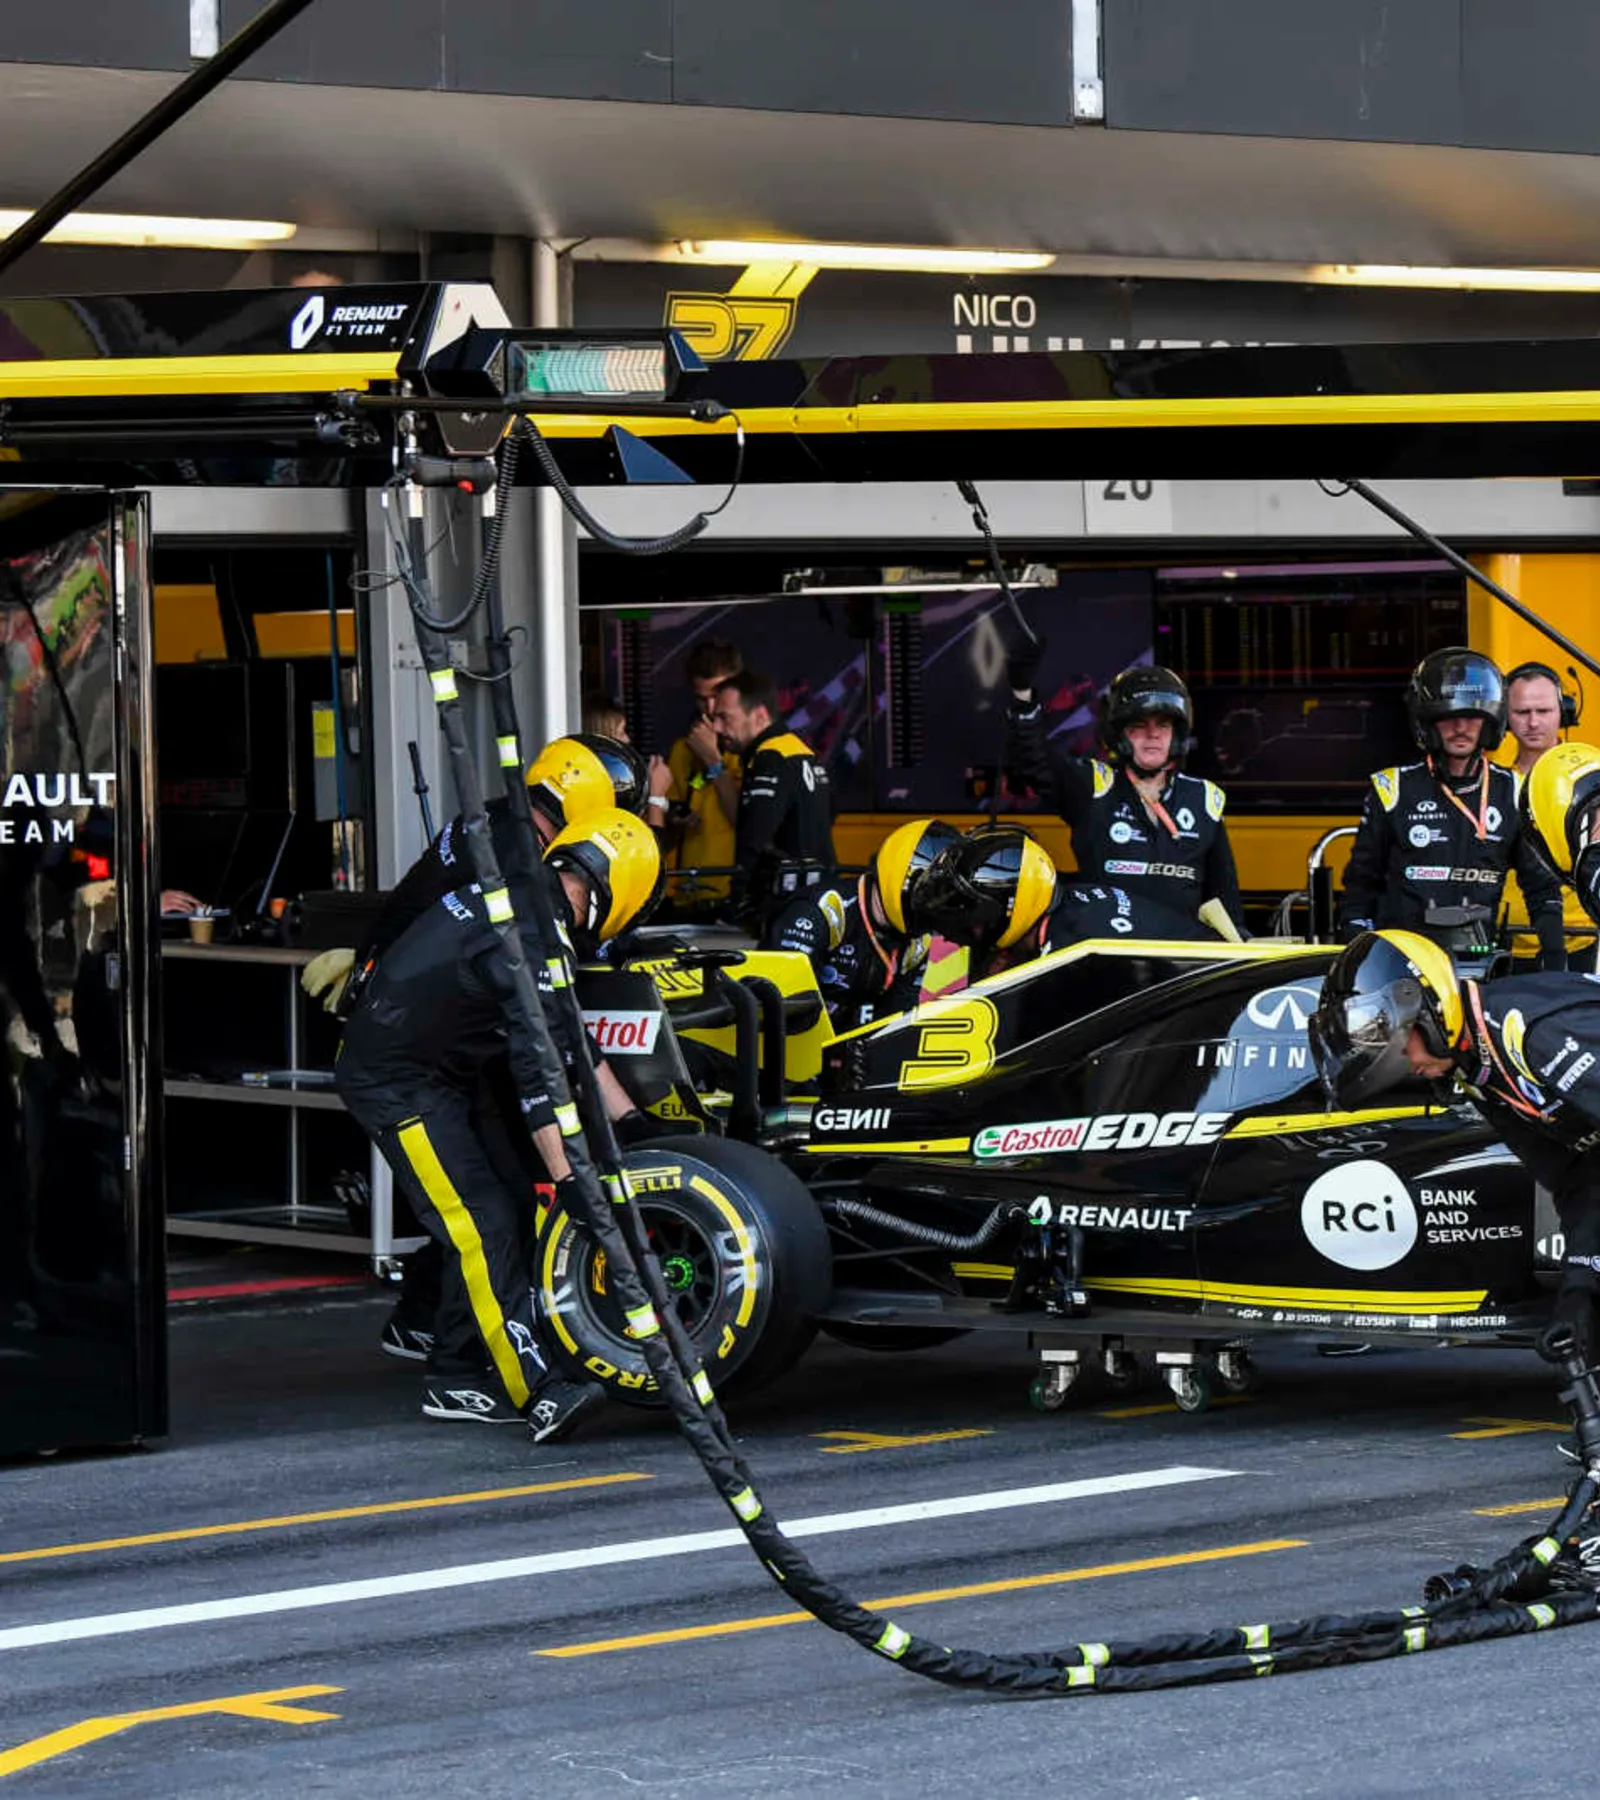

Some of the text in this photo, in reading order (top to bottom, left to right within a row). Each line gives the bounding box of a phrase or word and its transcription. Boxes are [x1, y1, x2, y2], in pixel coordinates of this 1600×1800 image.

[331, 304, 409, 322] RENAULT
[953, 293, 1037, 328] NICO
[324, 324, 386, 336] F1 TEAM
[3, 772, 117, 807] AULT
[0, 819, 75, 844] EAM
[899, 995, 999, 1091] 3
[1001, 1112, 1235, 1153] Castrol EDGE
[1419, 1189, 1478, 1207] BANK
[1058, 1205, 1192, 1232] RENAULT
[1322, 1195, 1397, 1233] RCi
[1424, 1210, 1470, 1227] AND
[1426, 1225, 1523, 1244] SERVICES
[1450, 1315, 1507, 1328] HECHTER
